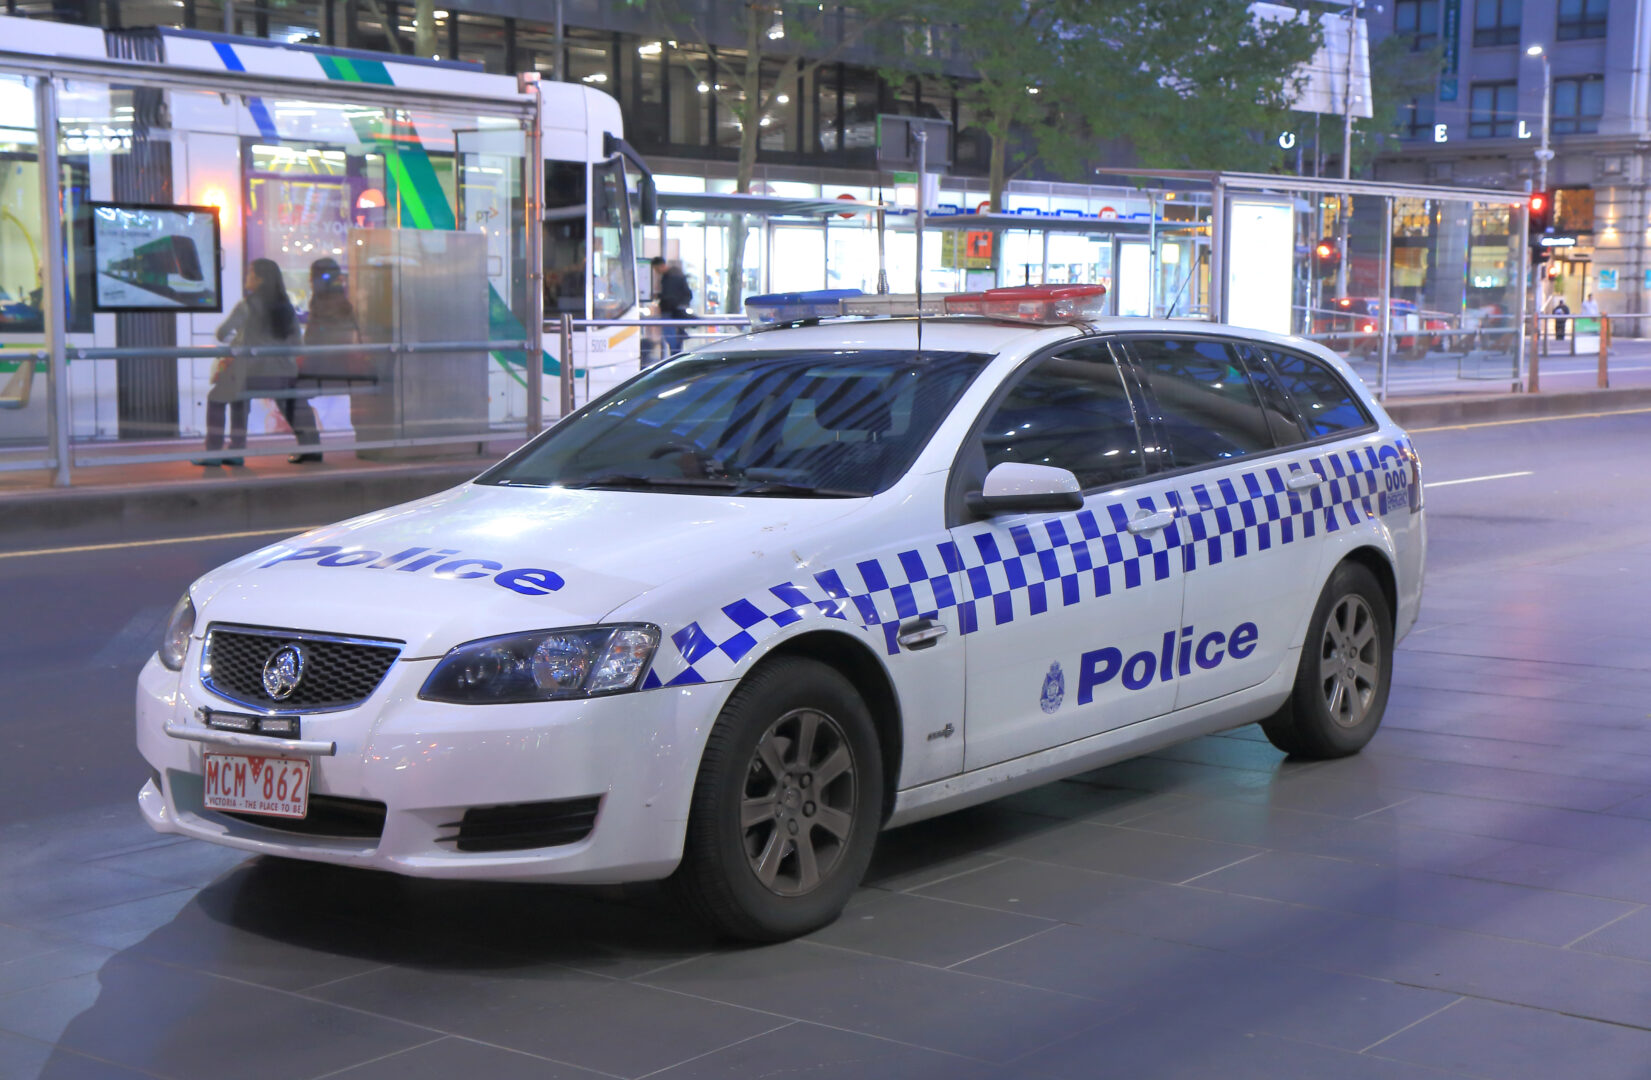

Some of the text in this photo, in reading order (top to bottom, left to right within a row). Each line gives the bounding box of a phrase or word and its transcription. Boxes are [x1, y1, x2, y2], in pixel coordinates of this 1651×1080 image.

[1384, 468, 1407, 492] 000
[258, 545, 566, 596] Police
[1077, 621, 1259, 706] Police
[207, 761, 303, 803] MCM 862
[208, 797, 237, 807] VICTORIA
[245, 800, 257, 809] THE
[259, 802, 278, 812] PLACE
[281, 804, 290, 812] TO
[293, 805, 301, 814] BE
